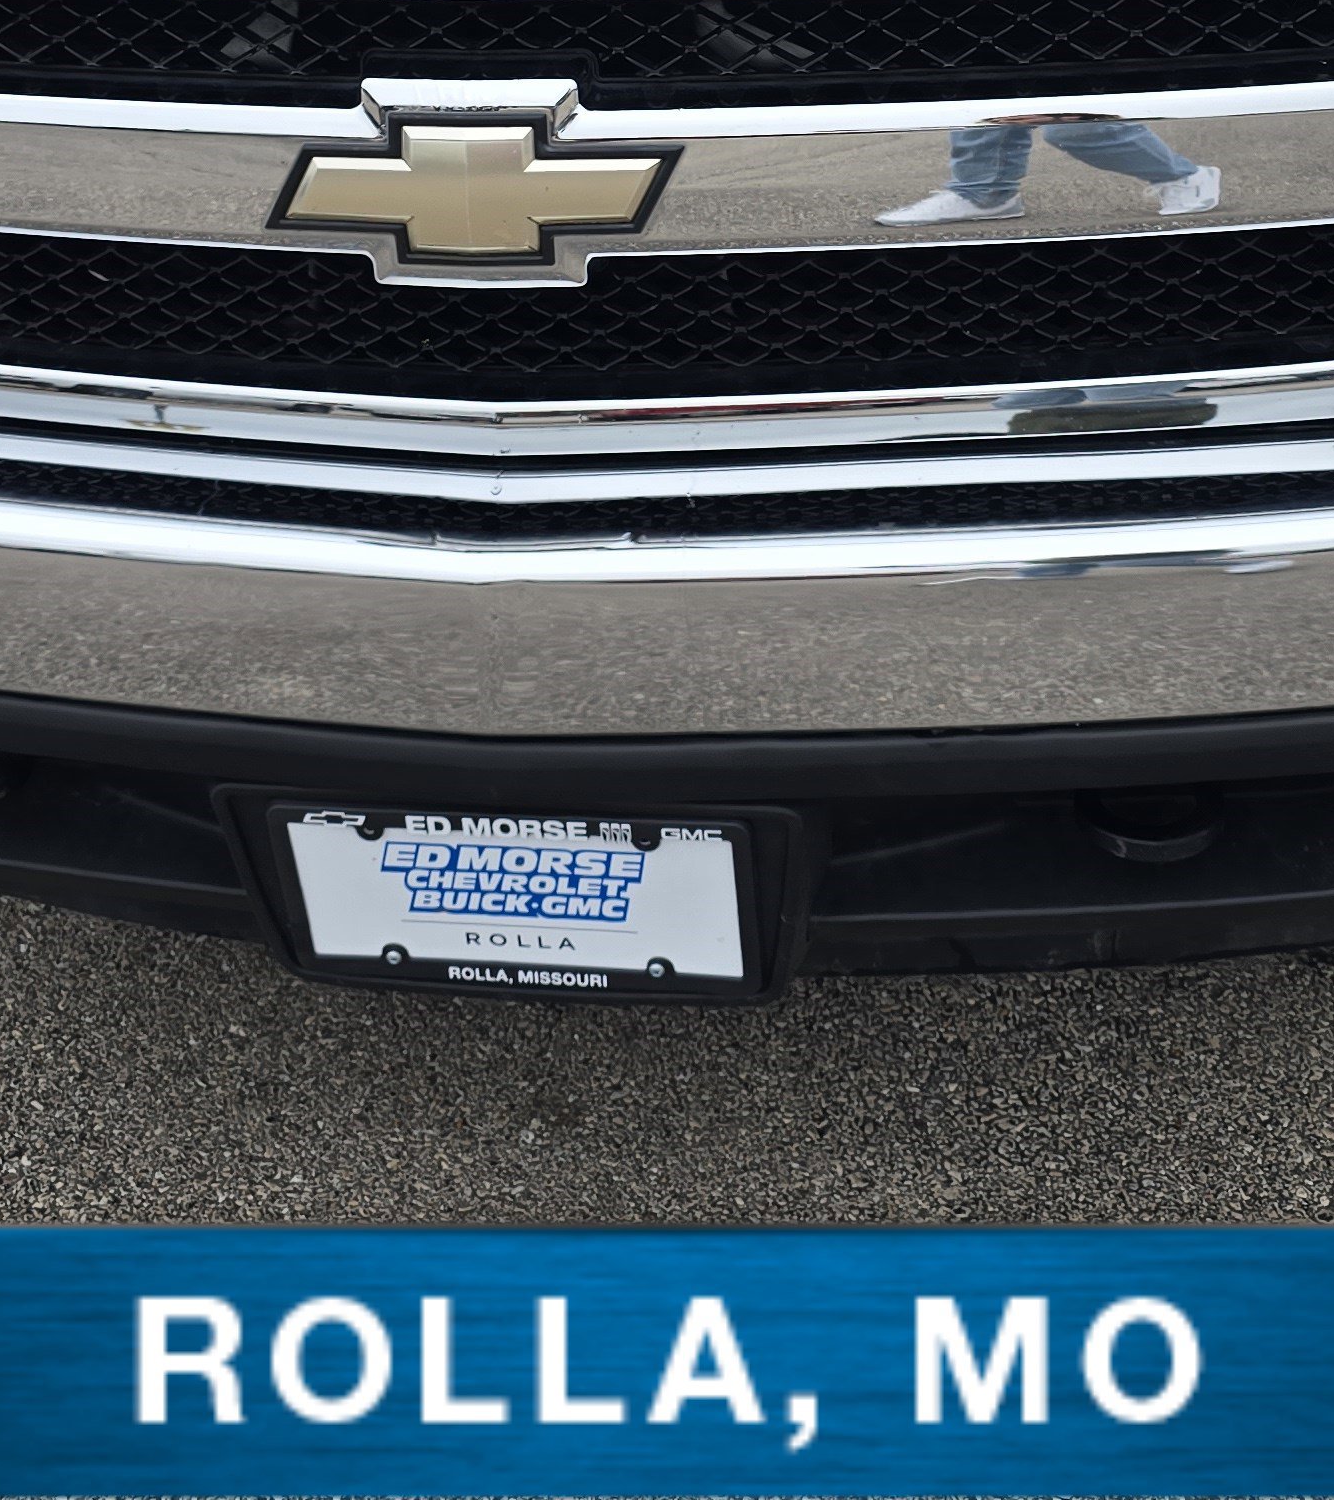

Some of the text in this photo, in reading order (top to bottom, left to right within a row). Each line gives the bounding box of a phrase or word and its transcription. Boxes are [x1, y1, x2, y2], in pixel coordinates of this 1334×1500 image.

[405, 815, 588, 842] ED MORSE
[660, 827, 723, 842] GMC
[383, 843, 643, 878] ED MORSE
[465, 932, 576, 951] ROLLA
[447, 965, 609, 989] ROLLA, MISSOURI
